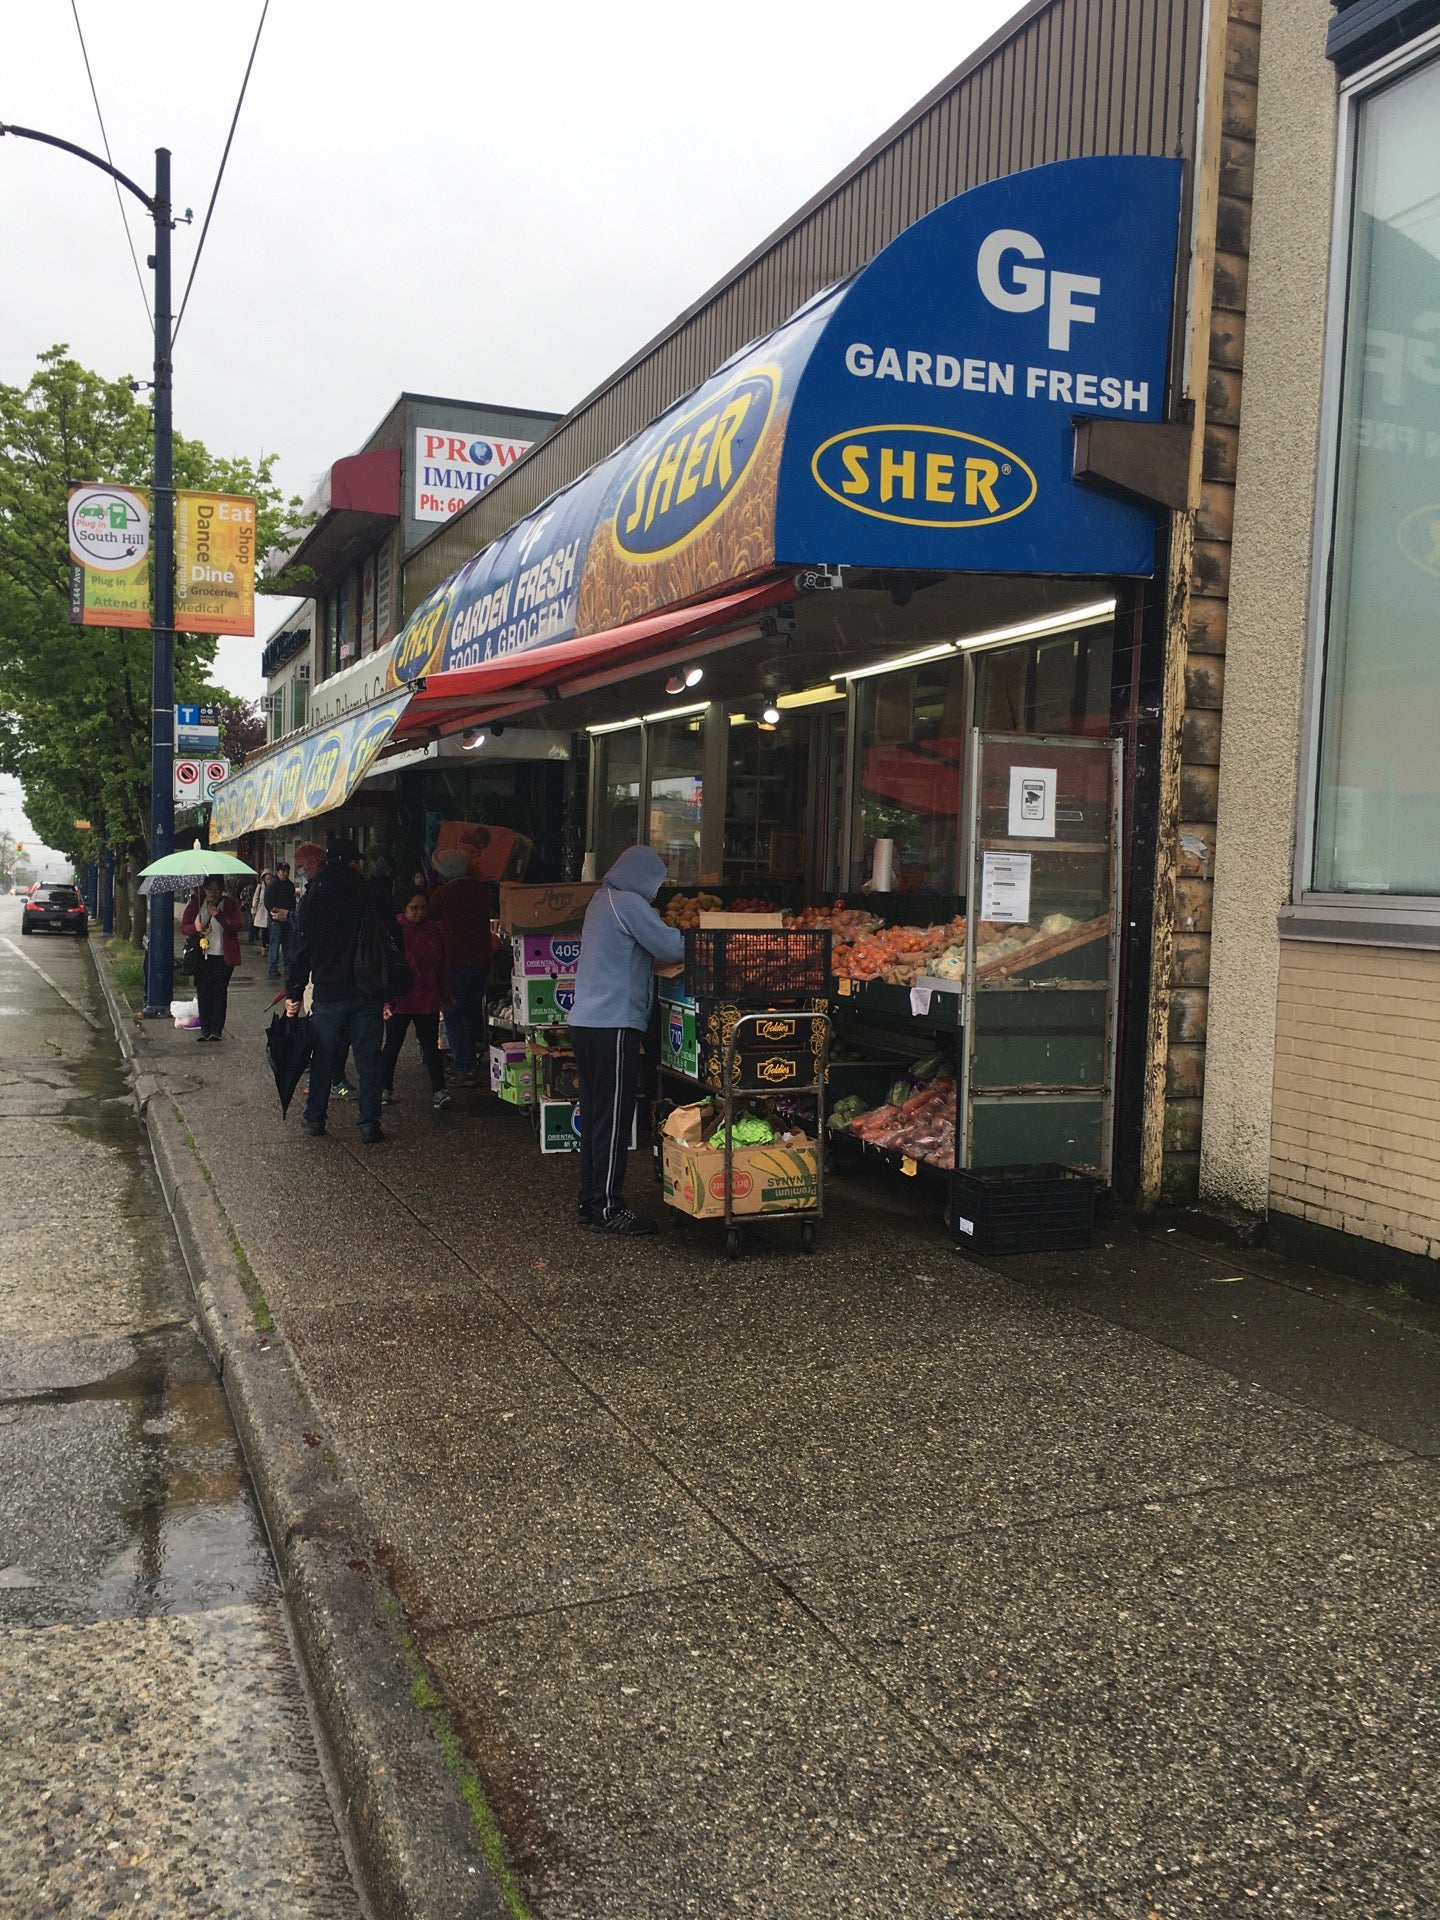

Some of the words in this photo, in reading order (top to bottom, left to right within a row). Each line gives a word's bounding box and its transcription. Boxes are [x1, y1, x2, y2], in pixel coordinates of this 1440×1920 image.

[977, 229, 1101, 352] GF
[845, 343, 1014, 396] GARDEN
[1026, 367, 1149, 412] FRESH
[424, 435, 527, 467] PROW
[626, 393, 753, 534] SHER
[423, 466, 498, 492] IMMI
[841, 445, 1001, 513] SHER
[218, 503, 253, 523] Eat
[420, 493, 444, 512] Ph:
[447, 498, 466, 513] 60
[76, 519, 96, 530] Plug
[97, 520, 107, 529] in
[178, 500, 188, 550] Business
[197, 505, 214, 563] Dance
[79, 530, 118, 544] South
[122, 534, 145, 545] Hill
[236, 526, 252, 564] Shop
[72, 567, 81, 583] Ave
[91, 576, 114, 588] Plug
[178, 554, 188, 599] Conduct
[191, 565, 234, 584] Dine
[190, 586, 239, 598] Groceries
[452, 578, 514, 650] GARDEN
[513, 538, 580, 617] FRESH
[93, 597, 137, 609] Attend
[175, 602, 224, 614] Medical
[398, 602, 445, 669] SHER
[449, 643, 480, 671] FOOD
[484, 637, 493, 661] &
[498, 595, 571, 654] GROCERY
[181, 707, 194, 723] T
[556, 944, 580, 957] 405
[526, 960, 556, 968] ORIENTAL
[558, 993, 575, 1004] 71
[671, 1029, 682, 1045] 710
[775, 1186, 817, 1197] Premium
